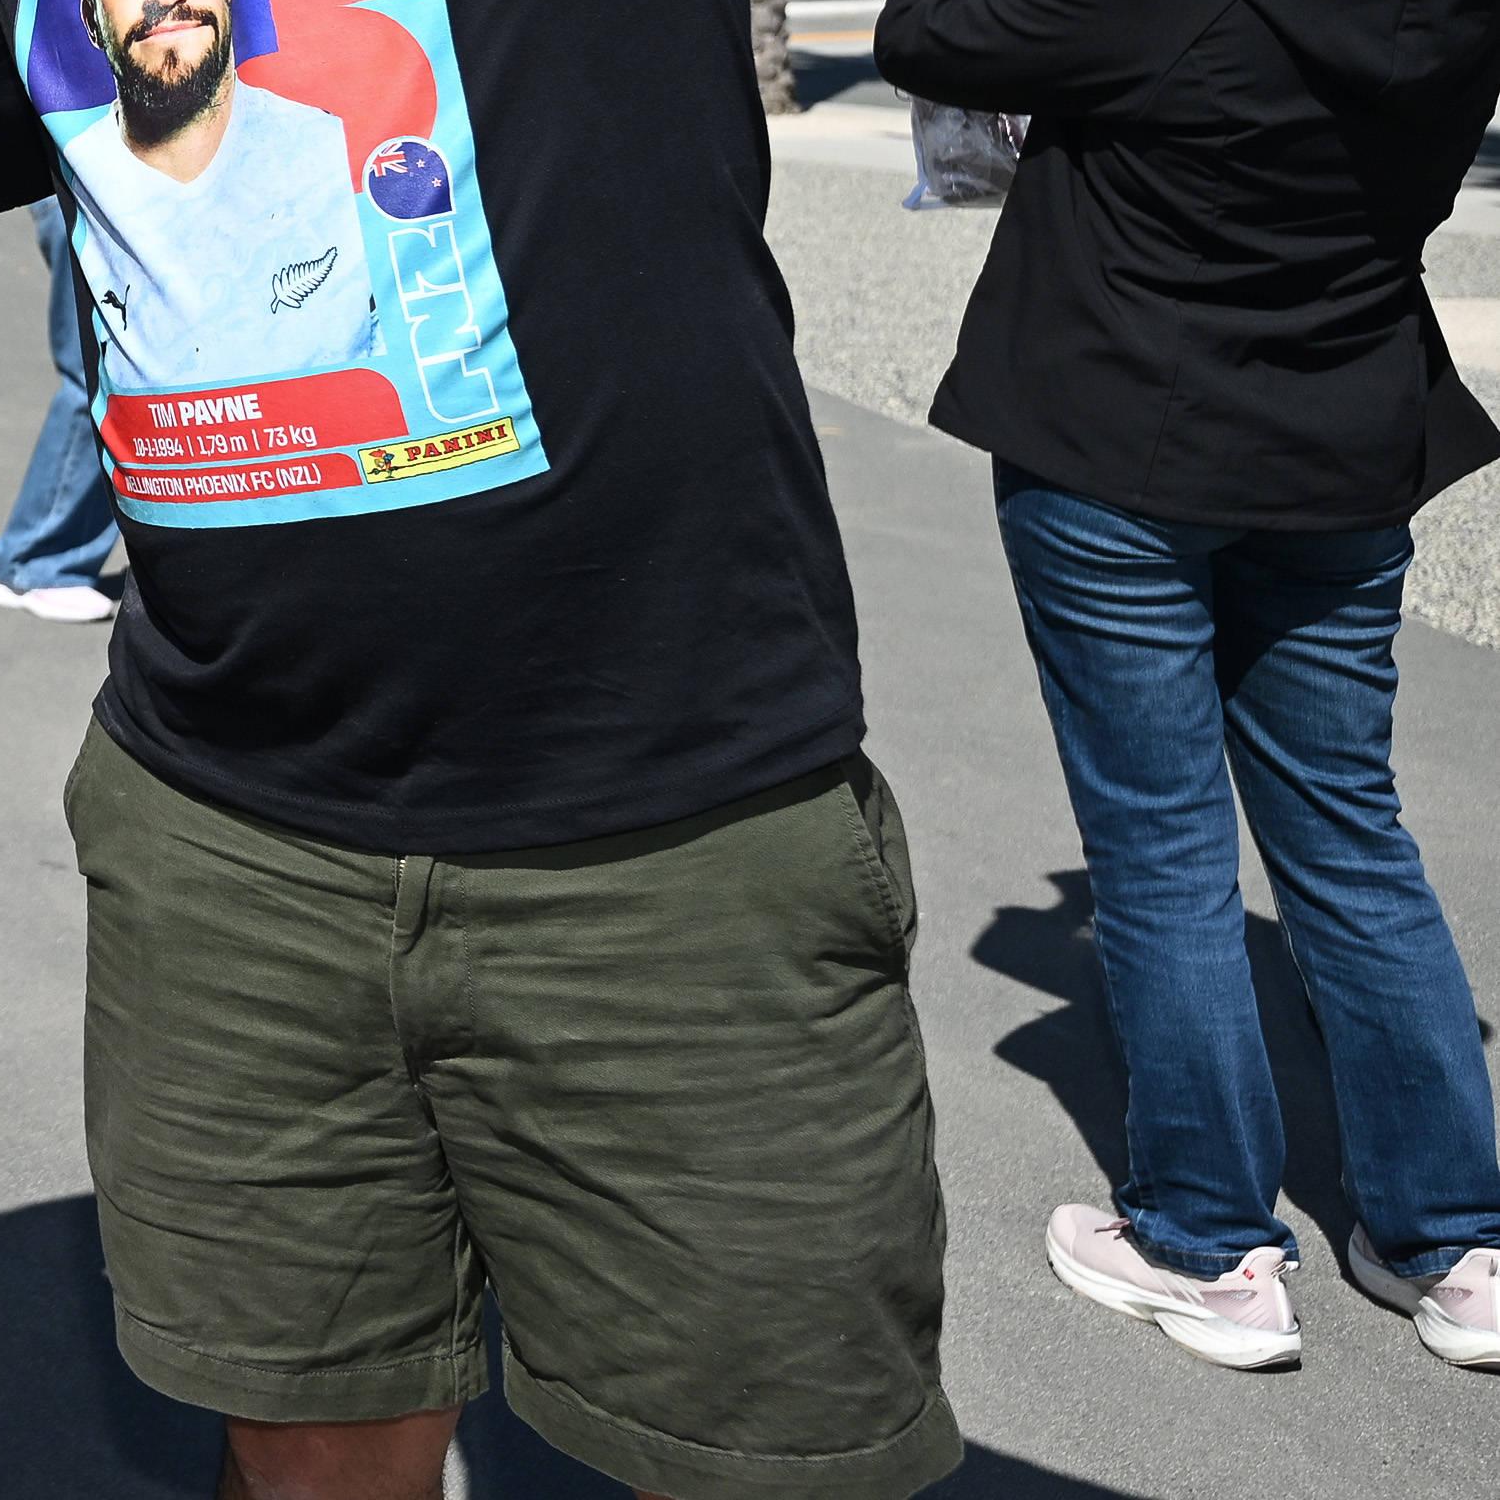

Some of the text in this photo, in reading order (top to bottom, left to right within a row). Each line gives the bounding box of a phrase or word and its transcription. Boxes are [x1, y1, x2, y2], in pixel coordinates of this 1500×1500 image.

[148, 392, 264, 429] TIM PAYNE
[132, 437, 185, 458] 10-1-1994
[196, 433, 229, 457] 1,79
[230, 435, 249, 453] m
[263, 426, 289, 449] 73
[288, 424, 318, 448] kg
[404, 423, 509, 462] PANINI
[124, 462, 322, 498] WELLINGTON PHOENIX FC (NZL)
